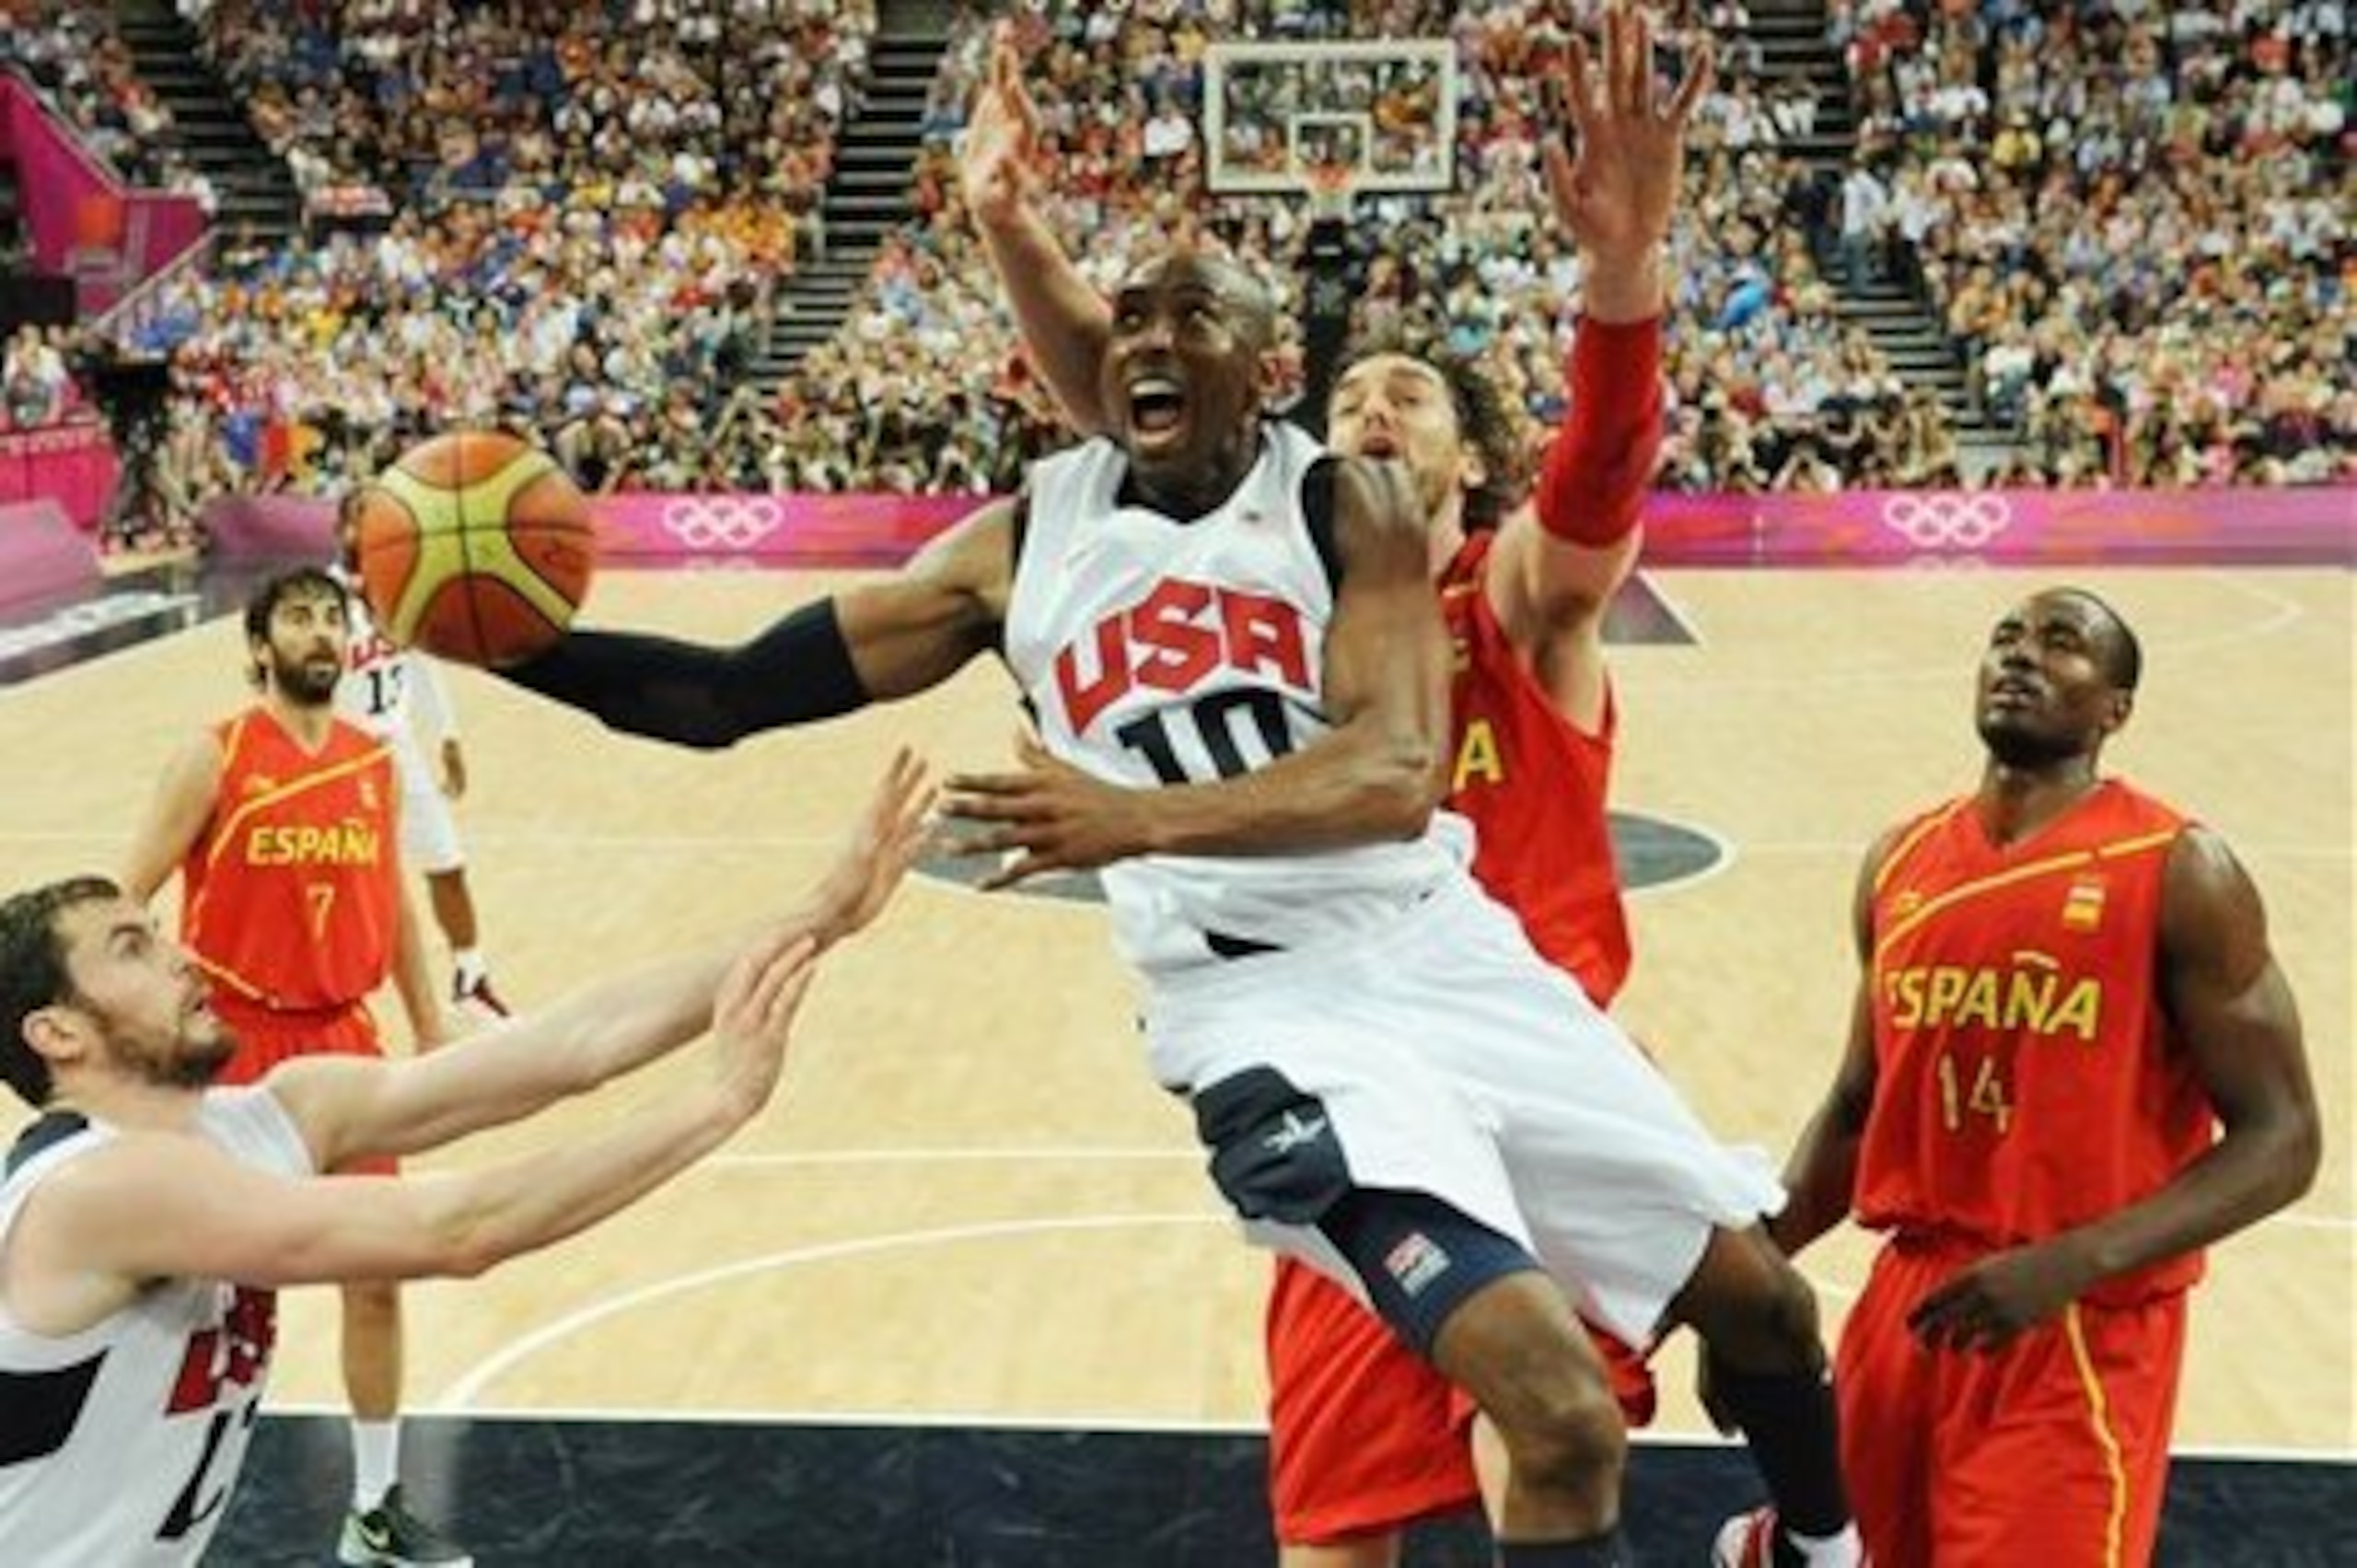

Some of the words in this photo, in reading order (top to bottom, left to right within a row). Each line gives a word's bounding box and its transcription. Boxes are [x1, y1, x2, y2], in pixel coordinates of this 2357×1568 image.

[1054, 579, 1311, 738] USA
[1115, 687, 1292, 784] 10
[306, 884, 334, 940] 7
[1938, 1056, 2013, 1133] 14
